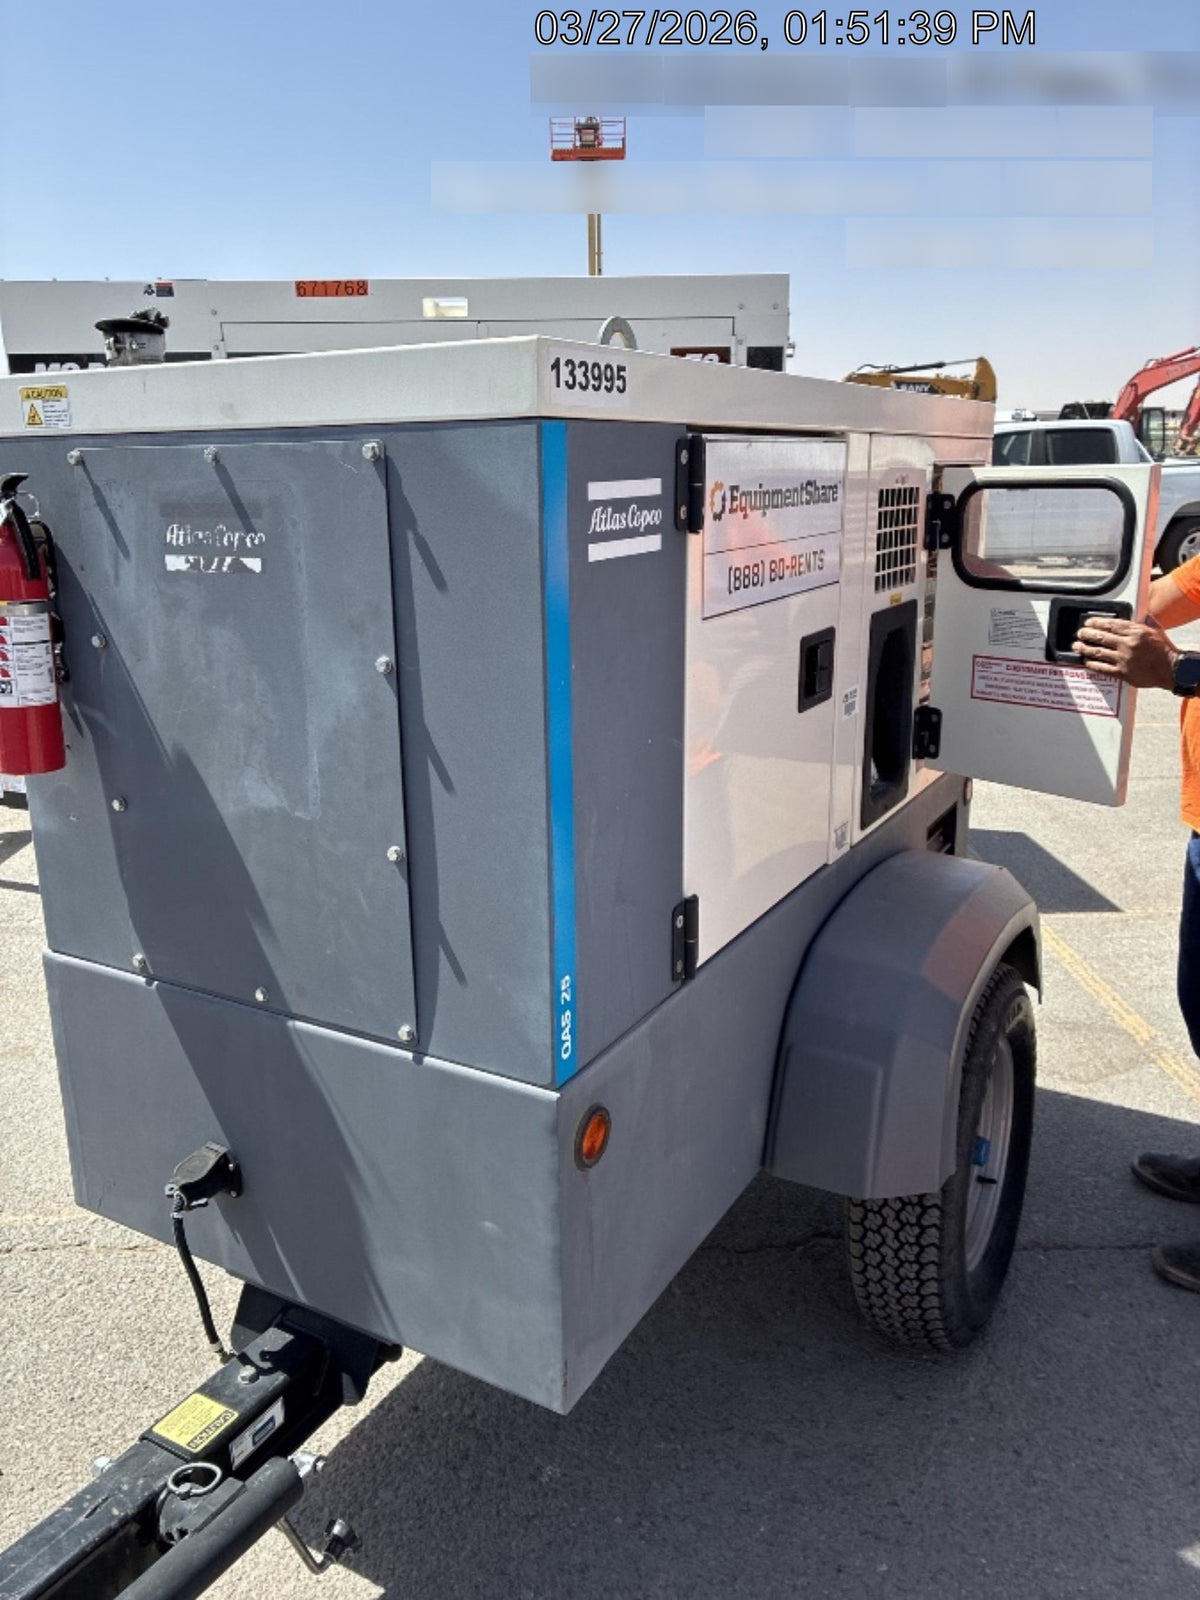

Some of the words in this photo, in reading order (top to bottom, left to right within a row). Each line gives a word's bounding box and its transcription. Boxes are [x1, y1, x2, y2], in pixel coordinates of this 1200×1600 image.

[297, 281, 368, 296] 671768
[550, 356, 627, 394] 133995
[728, 479, 839, 519] EquipmentShare
[587, 506, 627, 534] Atlas
[627, 504, 662, 532] Copco
[727, 560, 766, 595] (888)
[561, 974, 572, 1005] 25
[561, 1009, 572, 1060] QAS
